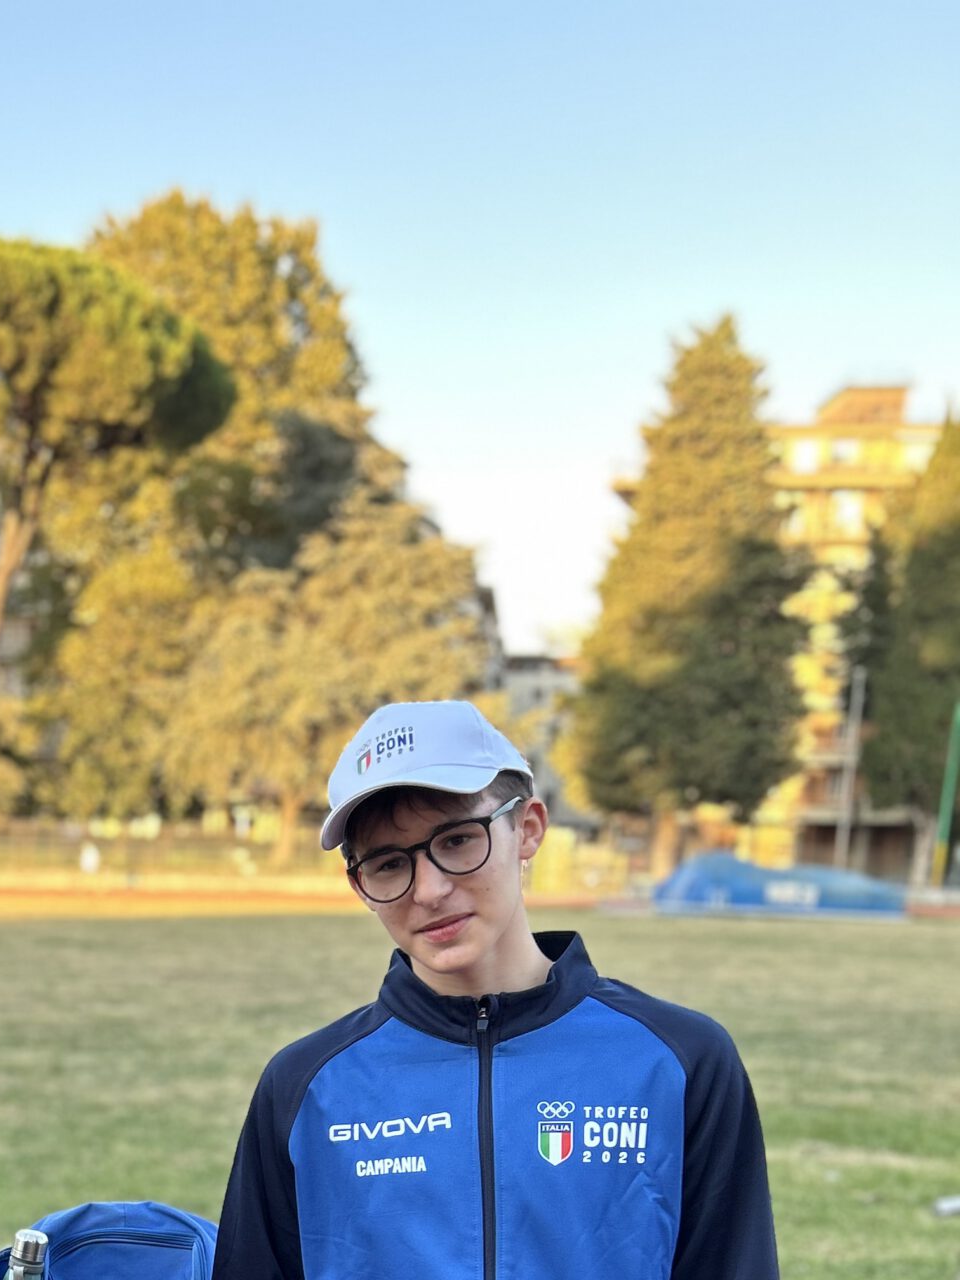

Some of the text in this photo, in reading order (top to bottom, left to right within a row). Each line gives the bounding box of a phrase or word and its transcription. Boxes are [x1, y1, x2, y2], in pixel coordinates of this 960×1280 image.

[376, 726, 414, 742] TROFEO
[376, 733, 414, 755] CONI
[583, 1106, 648, 1119] TROFEO
[329, 1112, 451, 1141] GIVOVA
[583, 1121, 648, 1148] CONI
[356, 1156, 427, 1177] CAMPANIA
[582, 1150, 646, 1163] 2026
